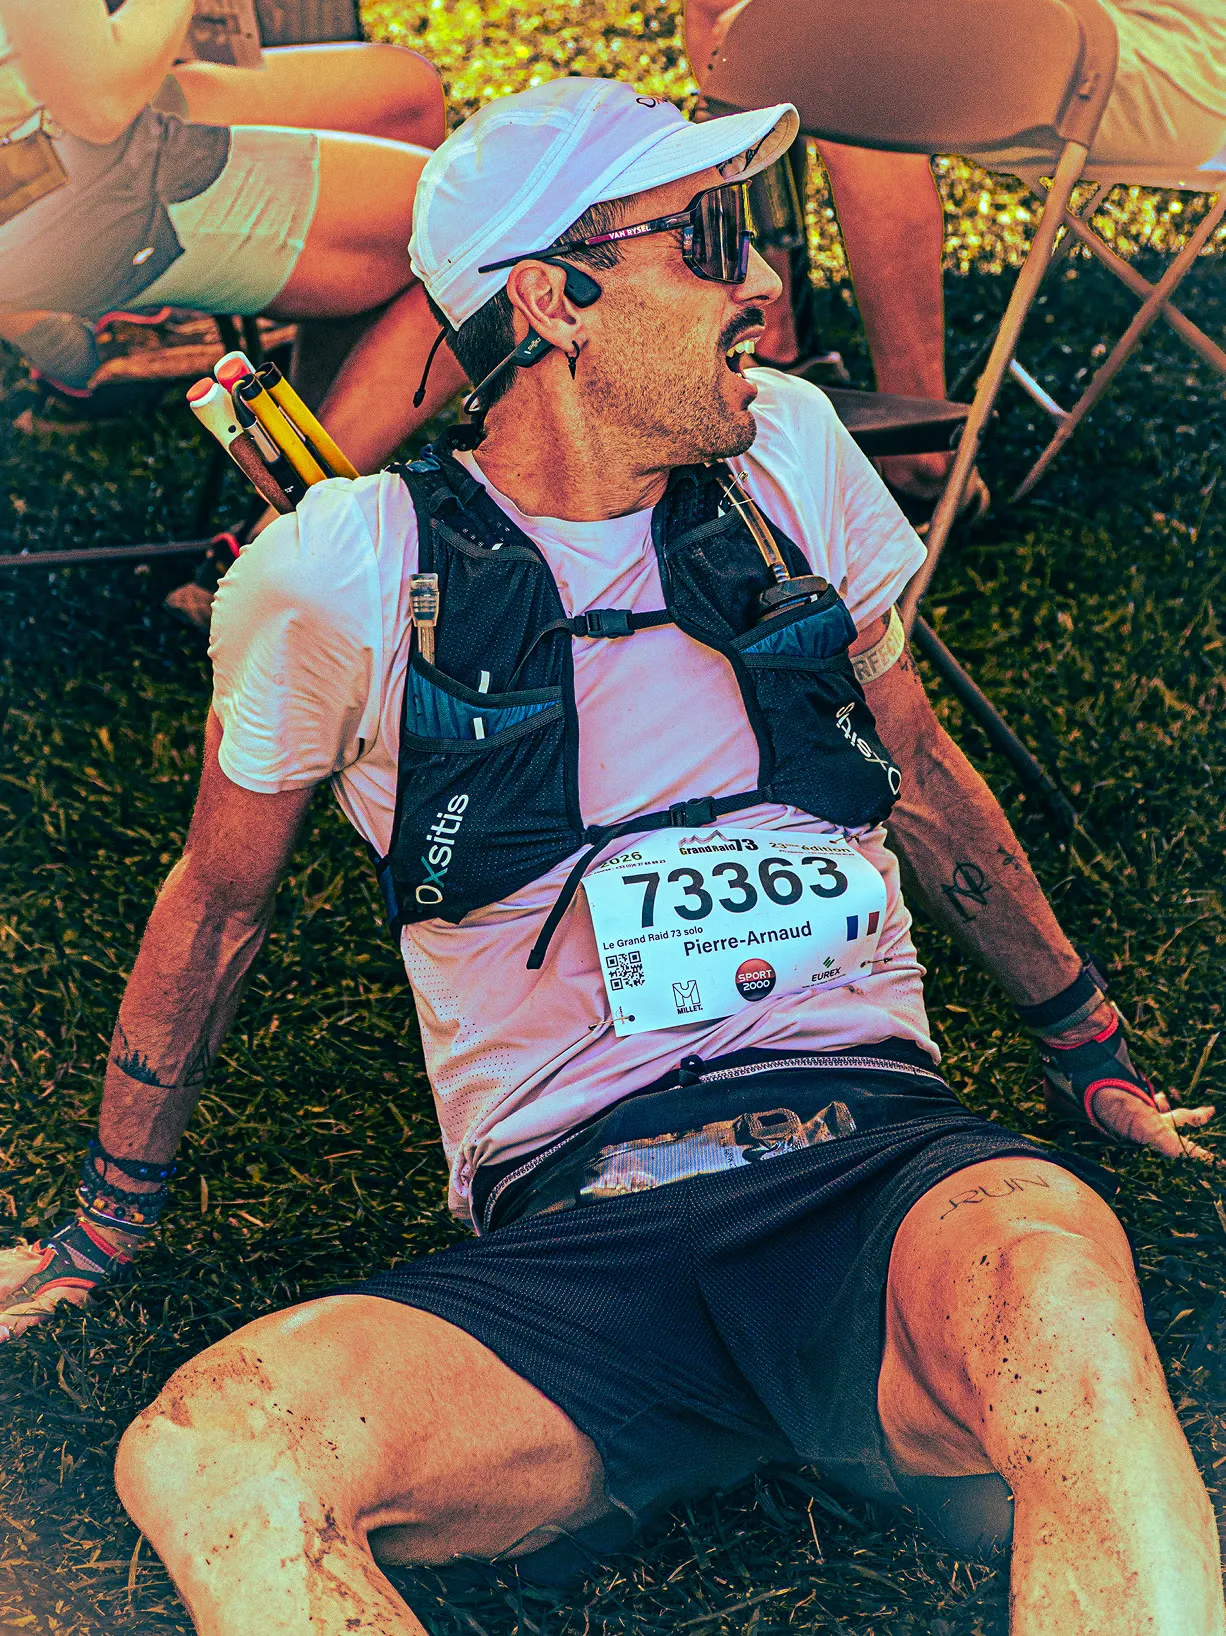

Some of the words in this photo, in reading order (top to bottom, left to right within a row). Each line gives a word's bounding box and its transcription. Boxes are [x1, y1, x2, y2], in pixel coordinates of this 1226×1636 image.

[609, 230, 626, 240] VAN
[627, 224, 652, 237] RYSEL
[801, 844, 852, 853] édition
[600, 851, 643, 868] 2026
[621, 856, 849, 928] 73363
[603, 942, 615, 951] Le
[617, 935, 646, 948] Grand
[648, 930, 669, 942] Raid
[670, 929, 682, 938] 73
[684, 926, 704, 936] solo
[683, 920, 813, 957] Pierre-Arnaud
[737, 969, 773, 983] SPORT
[811, 966, 842, 982] EUREX
[743, 980, 771, 992] 2000
[940, 1175, 1050, 1220] RUN
